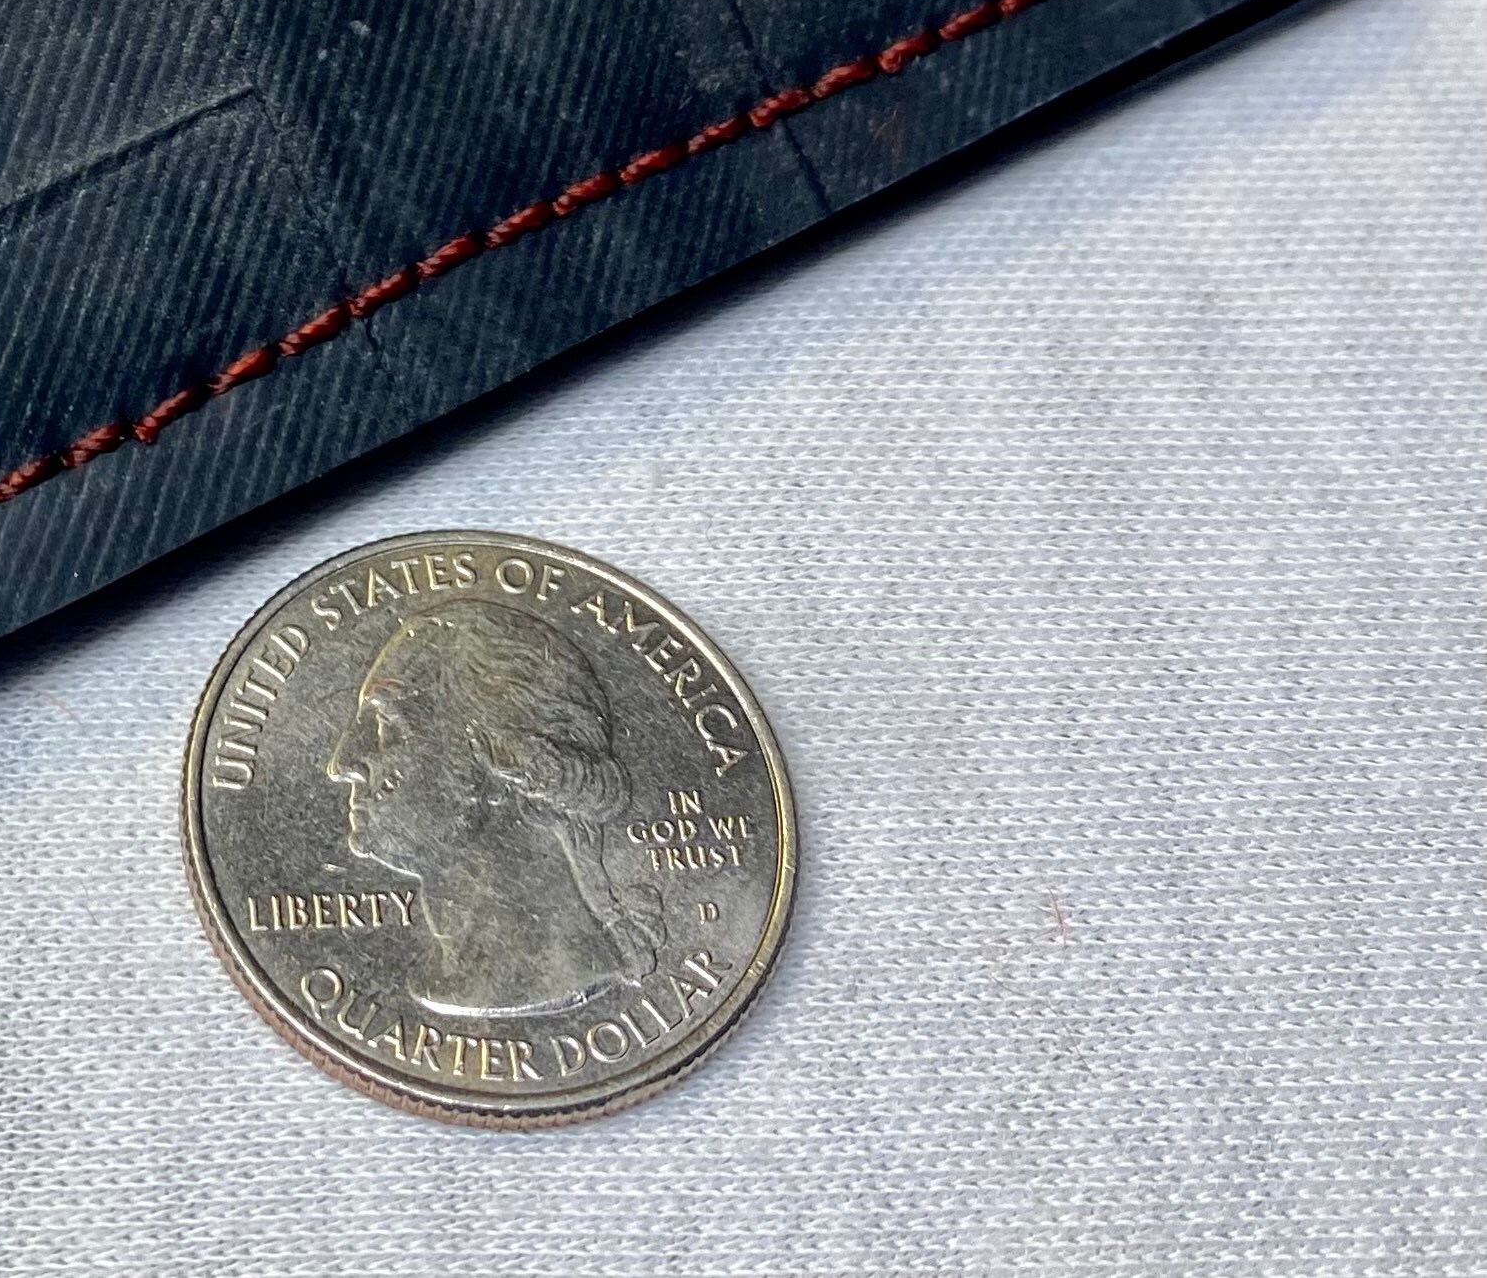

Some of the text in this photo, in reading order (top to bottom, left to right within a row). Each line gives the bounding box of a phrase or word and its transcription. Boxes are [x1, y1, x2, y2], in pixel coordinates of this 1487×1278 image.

[212, 551, 749, 790] UNITED STATES OF AMERICA
[667, 789, 704, 815] IN
[626, 818, 698, 844] GOD
[645, 844, 743, 871] TRUST
[246, 889, 415, 931] LIBERTY
[299, 947, 733, 1083] QUARTER DOLLAR
